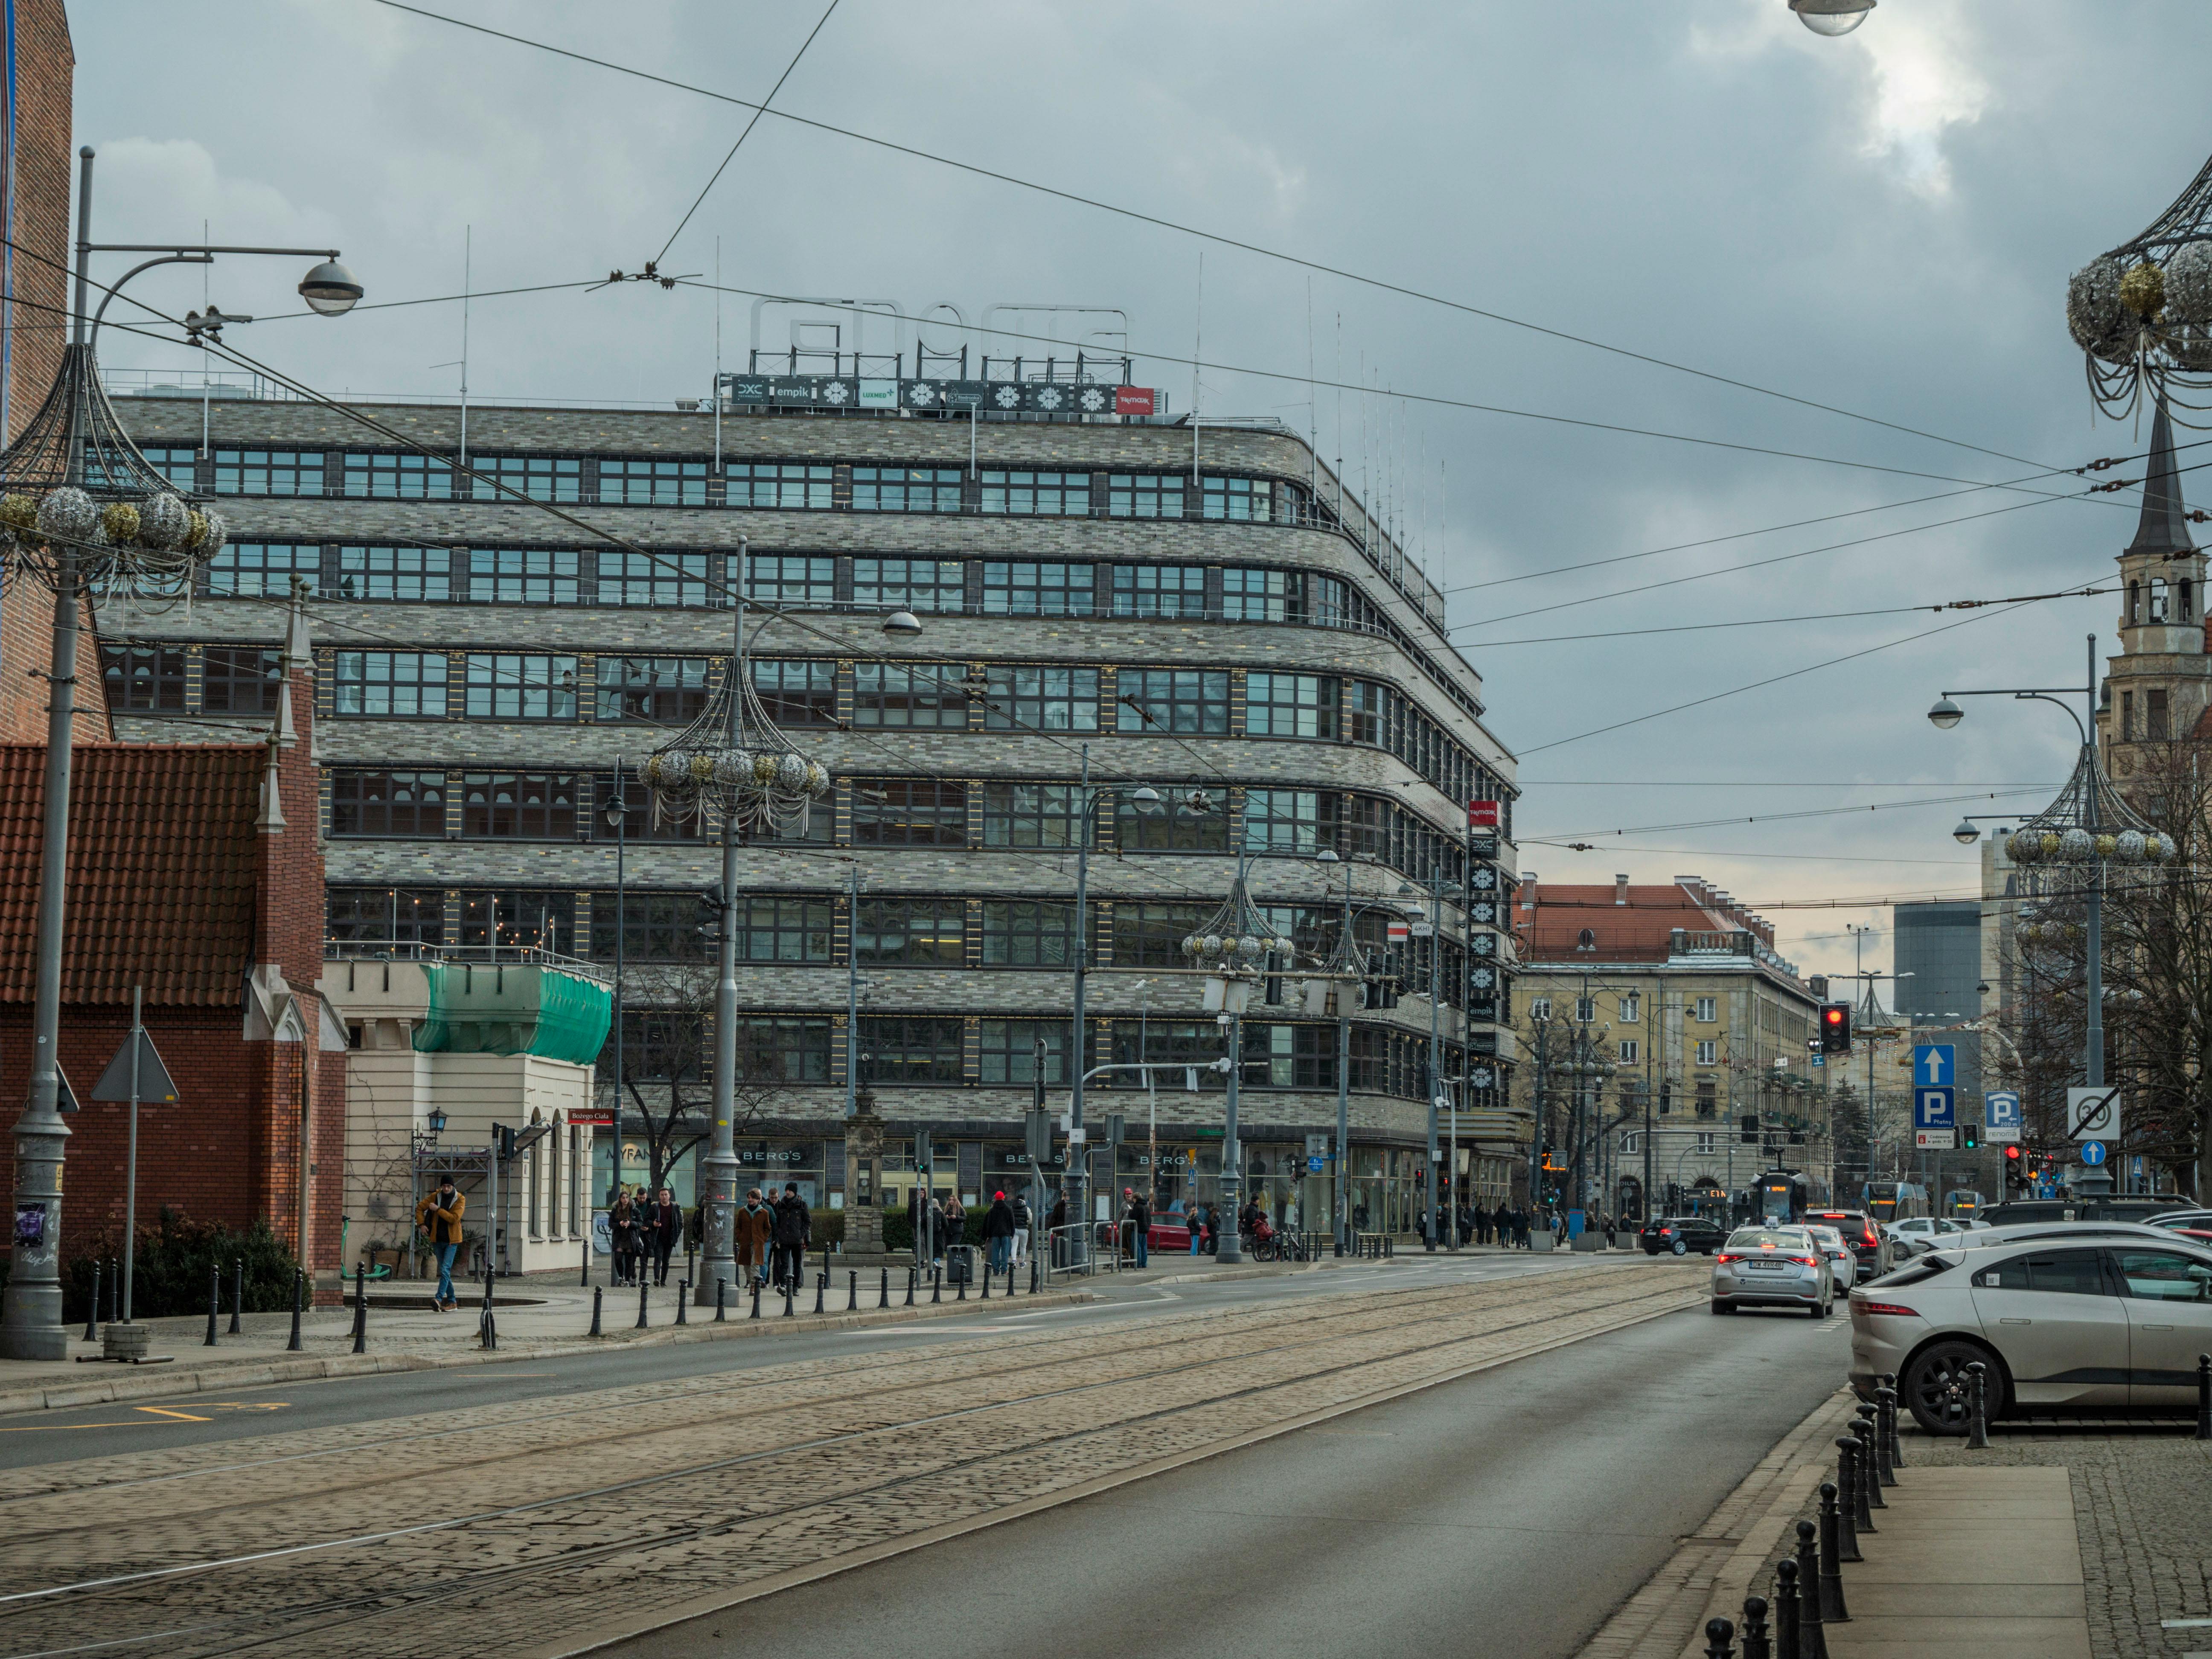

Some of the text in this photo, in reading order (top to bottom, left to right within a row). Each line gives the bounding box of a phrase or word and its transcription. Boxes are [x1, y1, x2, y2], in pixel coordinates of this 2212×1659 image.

[777, 386, 809, 398] empik
[1470, 1006, 1493, 1015] empik
[1924, 1092, 1946, 1123] P
[1994, 1100, 2011, 1123] P
[743, 1150, 801, 1160] BERG'S
